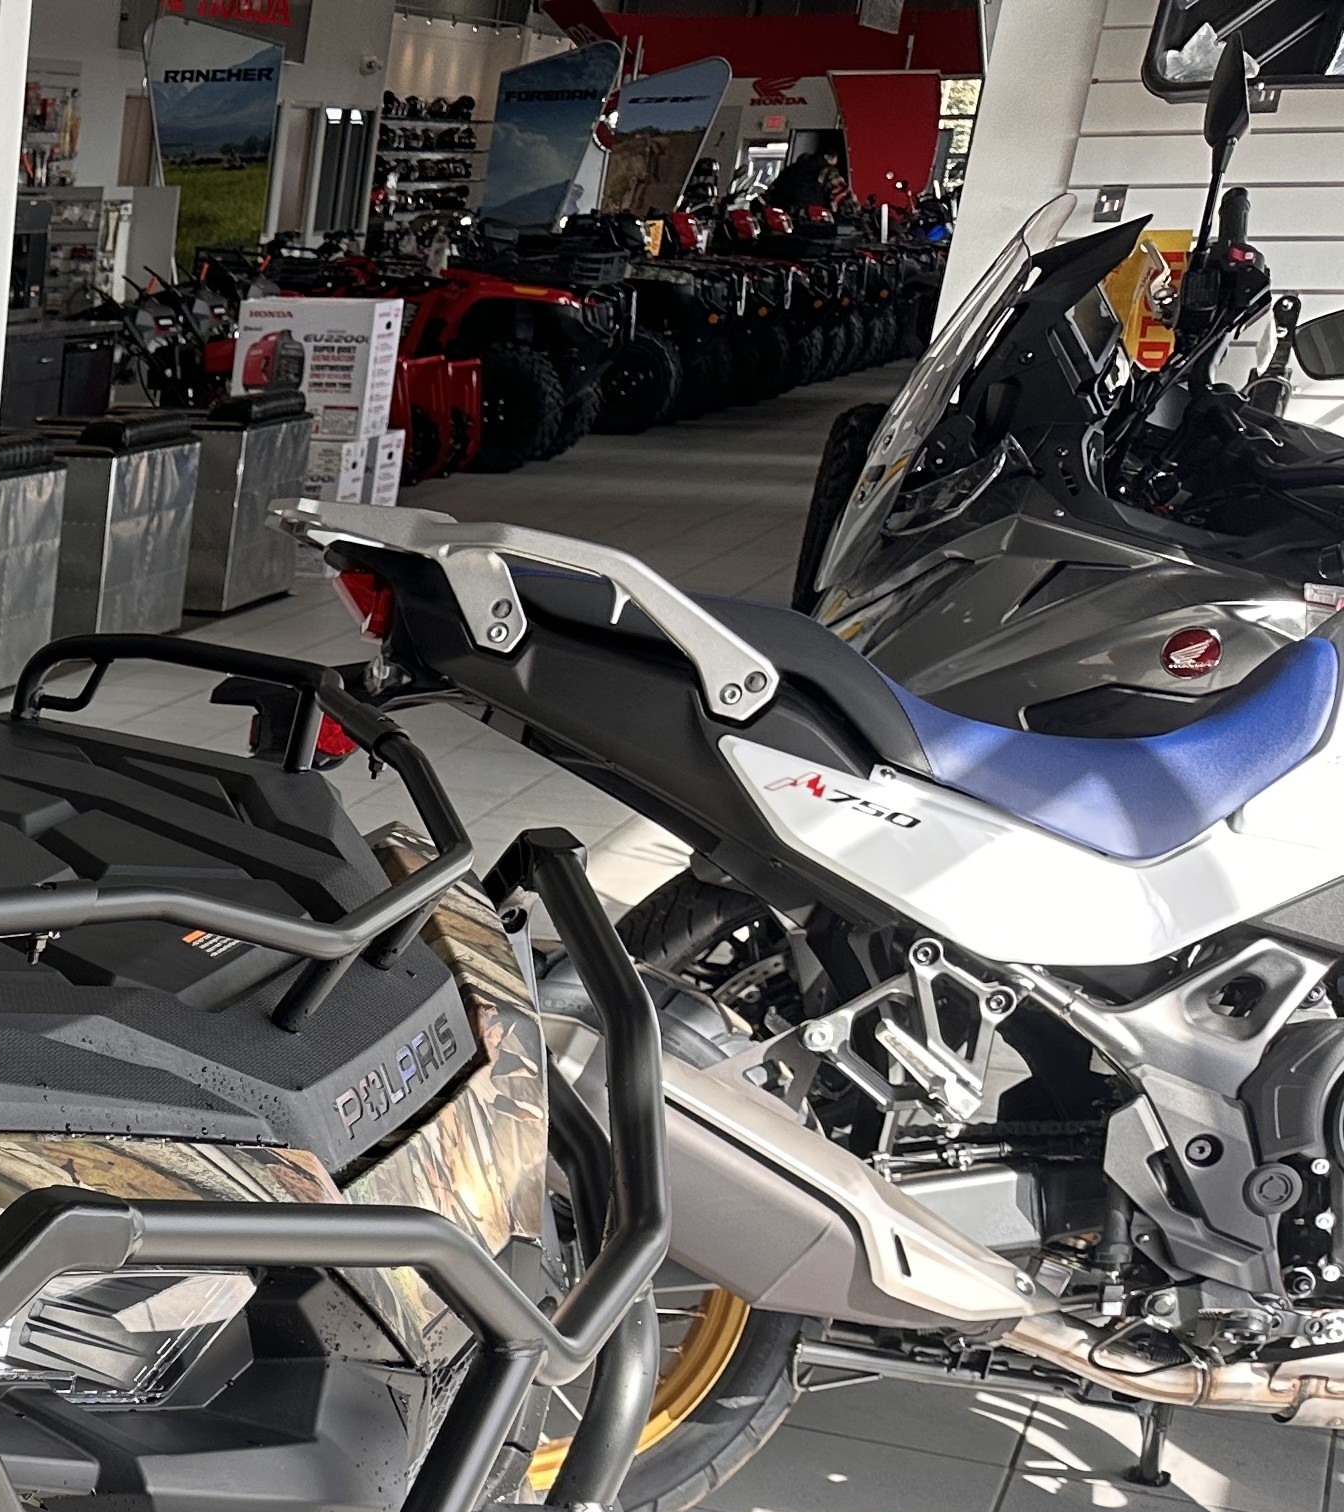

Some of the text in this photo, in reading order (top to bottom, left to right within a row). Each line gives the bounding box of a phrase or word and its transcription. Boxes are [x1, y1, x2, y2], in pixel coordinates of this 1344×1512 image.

[164, 67, 274, 84] RANCHER
[505, 88, 598, 104] FOREMAN
[749, 95, 808, 106] HONDA
[249, 310, 294, 319] HONDA
[826, 789, 922, 828] 750
[336, 1012, 457, 1140] POLARIS
